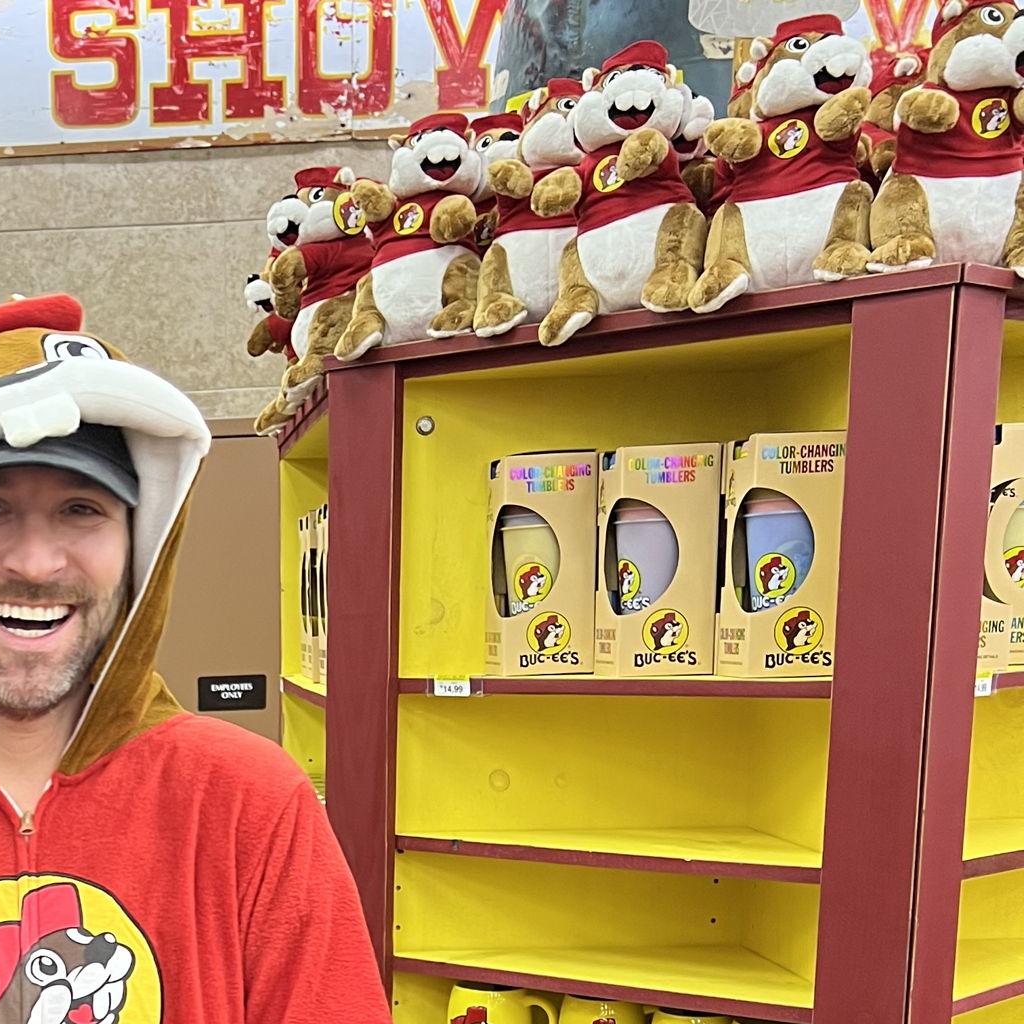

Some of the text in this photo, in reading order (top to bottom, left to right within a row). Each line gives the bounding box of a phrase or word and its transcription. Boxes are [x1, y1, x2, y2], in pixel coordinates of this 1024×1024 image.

[628, 455, 714, 471] COLOR-CHANGING
[779, 459, 835, 474] TUMBLERS
[509, 464, 592, 480] COLOR-CHANGING
[646, 470, 696, 485] TUMBLERS
[526, 479, 576, 493] TUMBLERS
[519, 651, 580, 668] BUC-EE'S
[634, 650, 697, 667] BUC-EE'S
[765, 651, 832, 669] BUC-EE'S
[210, 683, 253, 692] EMPLOYEES
[221, 691, 243, 699] ONLY
